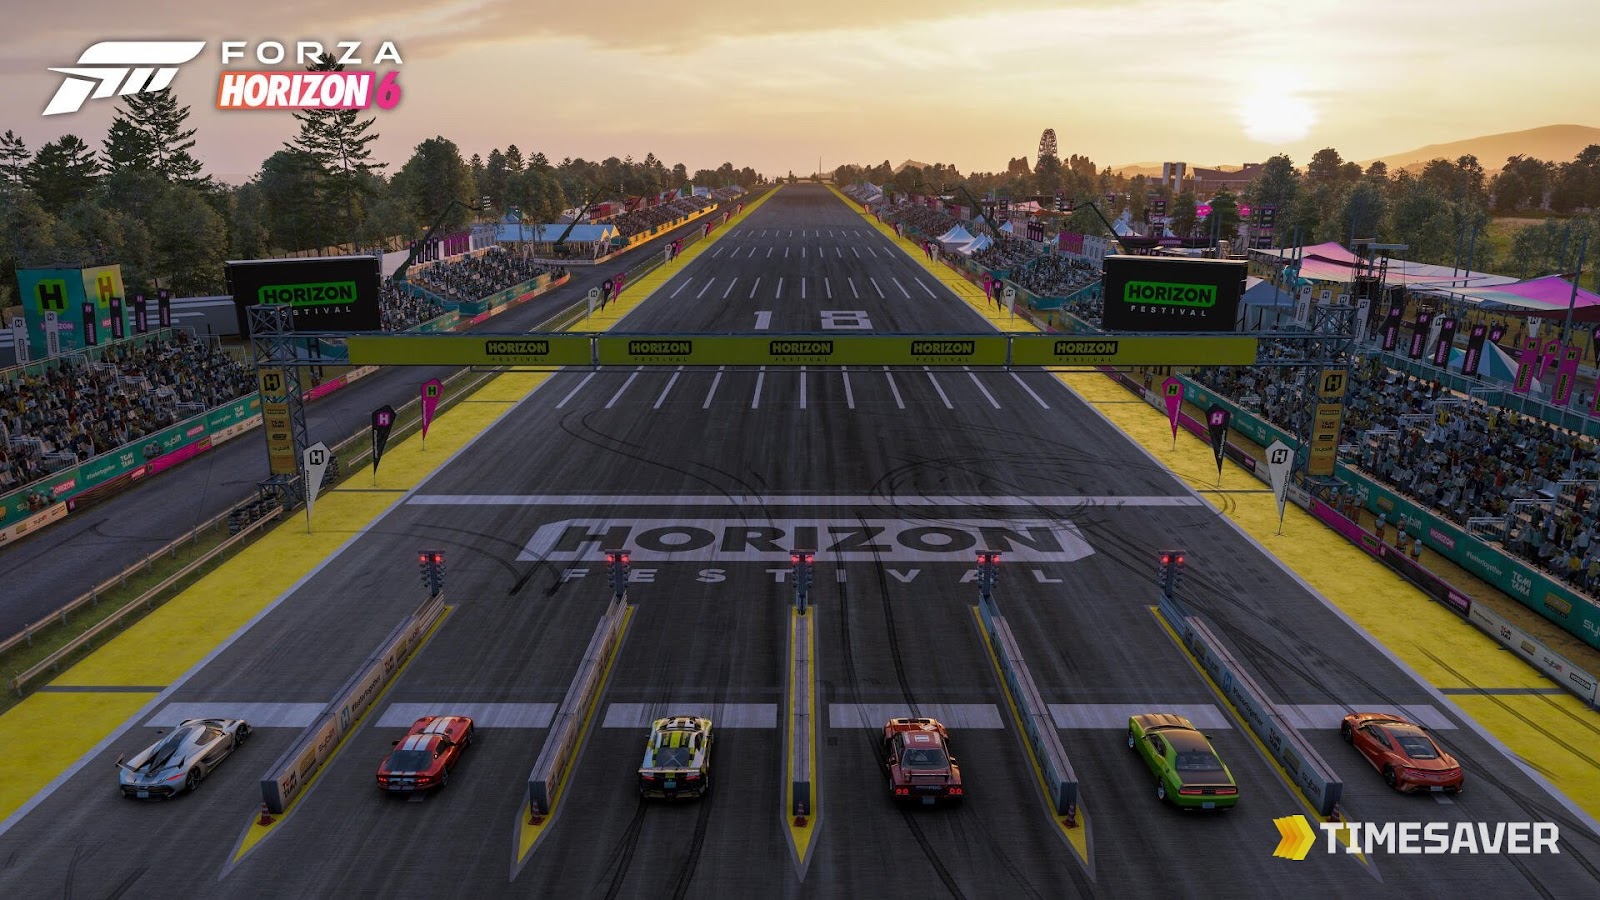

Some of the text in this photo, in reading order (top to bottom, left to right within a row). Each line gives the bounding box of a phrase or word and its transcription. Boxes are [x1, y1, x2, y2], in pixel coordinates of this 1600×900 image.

[39, 284, 64, 309] H
[263, 285, 352, 304] HORIZON
[1128, 284, 1212, 303] HORIZON
[1130, 305, 1207, 317] FESTIVAL
[754, 310, 874, 330] 1 8
[487, 342, 547, 354] HORIZON
[630, 342, 690, 354] HORIZON
[772, 342, 831, 354] HORIZON
[913, 342, 972, 354] HORIZON
[1056, 342, 1115, 354] HORIZON
[428, 386, 436, 395] H
[1168, 385, 1178, 394] H
[379, 413, 389, 425] H
[1211, 411, 1223, 426] H
[310, 450, 324, 465] H
[1271, 449, 1288, 465] H
[551, 526, 1064, 552] HORIZON
[560, 568, 1064, 583] FESTIVAL
